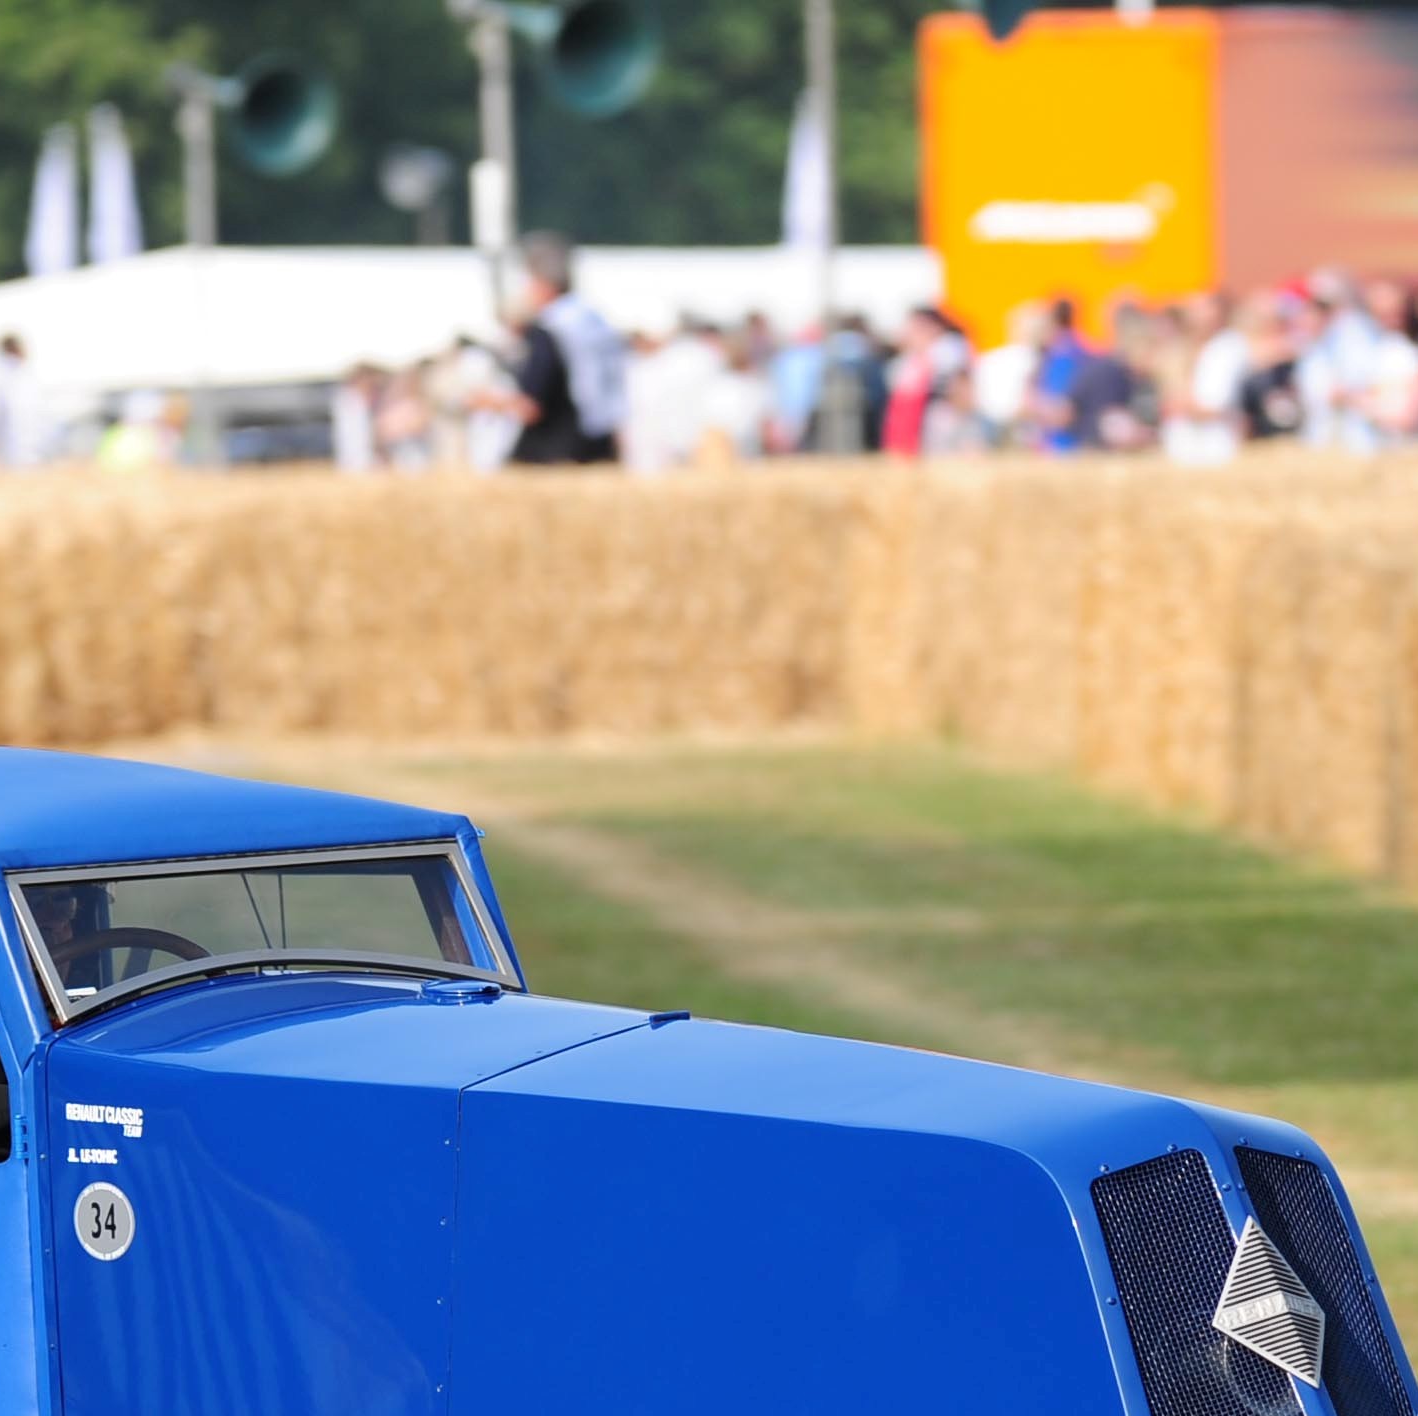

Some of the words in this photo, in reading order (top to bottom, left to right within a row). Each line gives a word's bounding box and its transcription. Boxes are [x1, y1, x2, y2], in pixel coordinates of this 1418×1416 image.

[65, 1102, 105, 1123] RENAULT
[105, 1105, 143, 1126] CLASSIC
[123, 1124, 143, 1138] TEAM
[91, 1201, 117, 1239] 34
